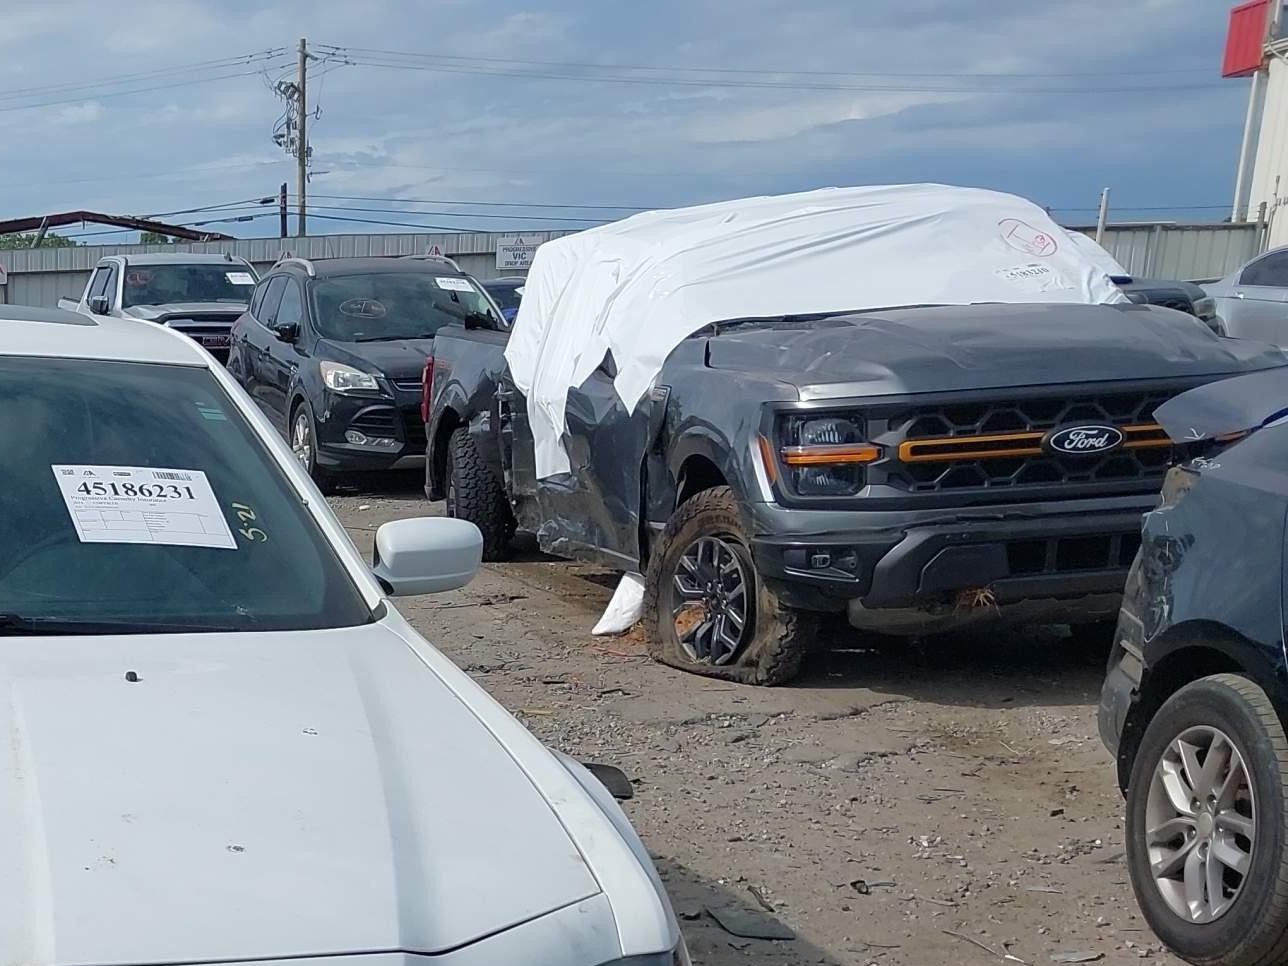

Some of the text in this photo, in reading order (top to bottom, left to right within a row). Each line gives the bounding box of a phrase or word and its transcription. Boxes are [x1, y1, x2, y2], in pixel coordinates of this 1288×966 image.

[512, 252, 527, 260] VIC
[1064, 429, 1109, 449] Ford
[77, 481, 197, 500] 45186231
